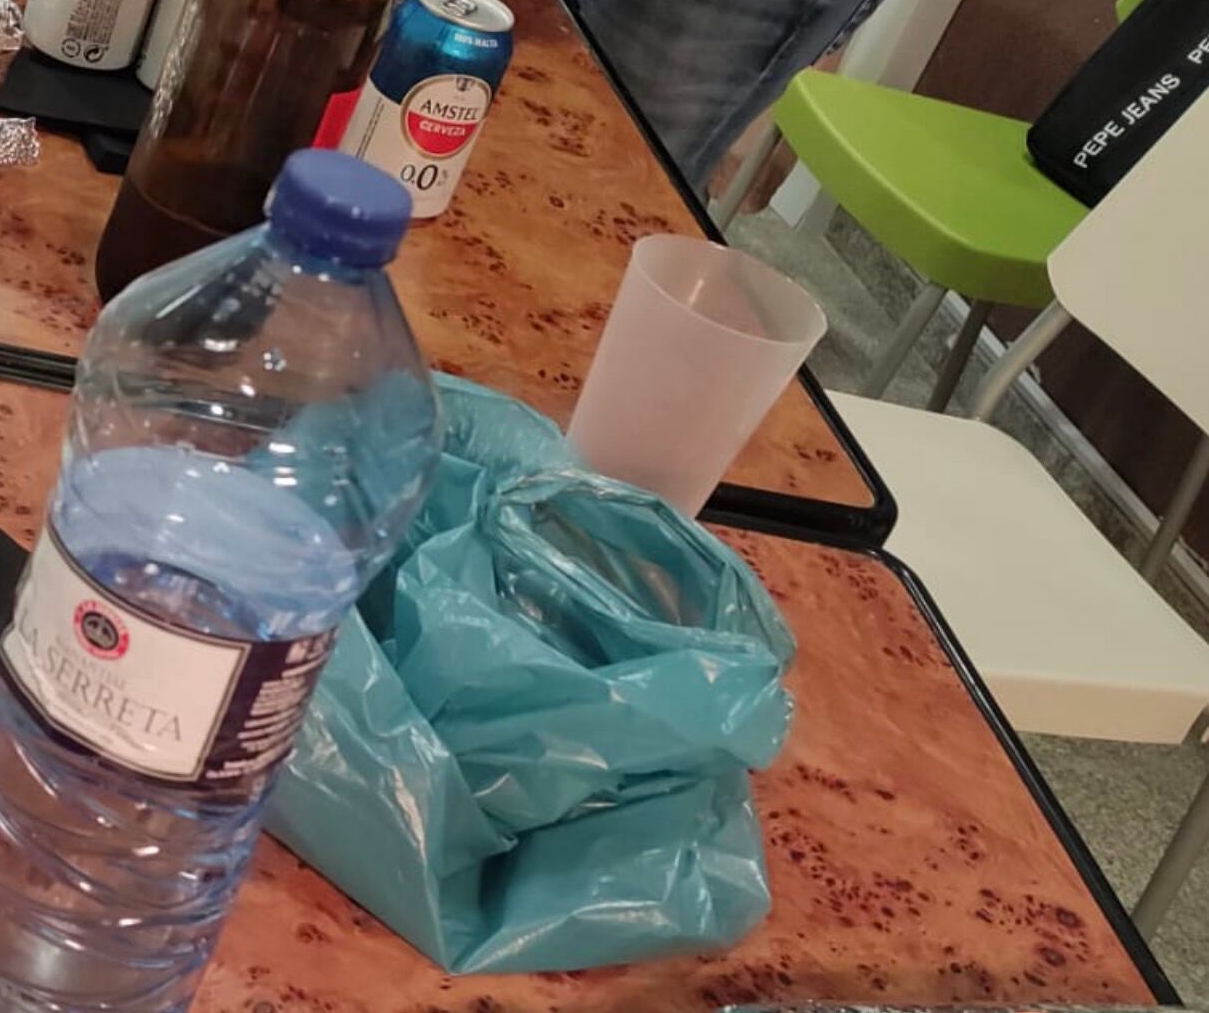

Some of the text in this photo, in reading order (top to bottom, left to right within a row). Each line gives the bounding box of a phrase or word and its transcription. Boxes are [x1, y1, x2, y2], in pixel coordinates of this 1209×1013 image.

[1187, 34, 1209, 64] PE
[420, 98, 480, 121] AMSTEL
[1073, 73, 1181, 169] PEPE JEANS
[418, 120, 467, 137] CERVEZA
[41, 646, 182, 742] SERRETA
